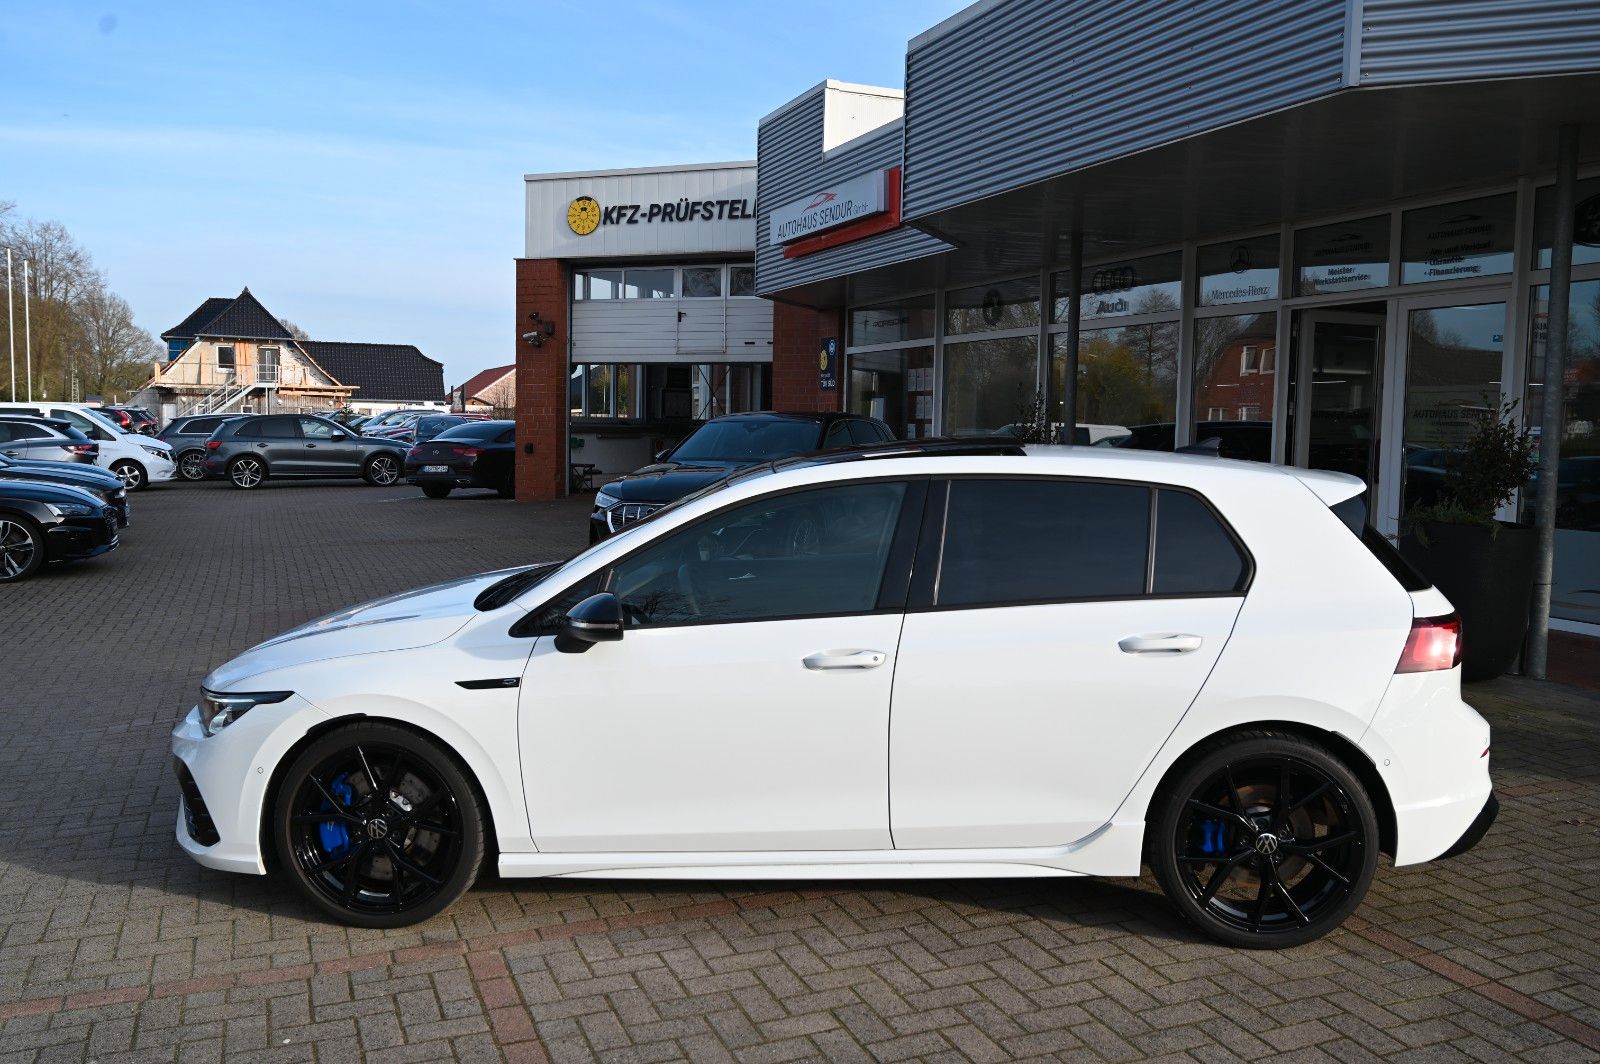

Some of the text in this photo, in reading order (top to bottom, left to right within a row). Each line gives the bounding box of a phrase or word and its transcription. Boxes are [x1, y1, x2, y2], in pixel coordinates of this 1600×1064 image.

[777, 211, 819, 240] AUTOHAUS
[819, 200, 853, 227] SENDUR
[1096, 298, 1128, 315] Audi
